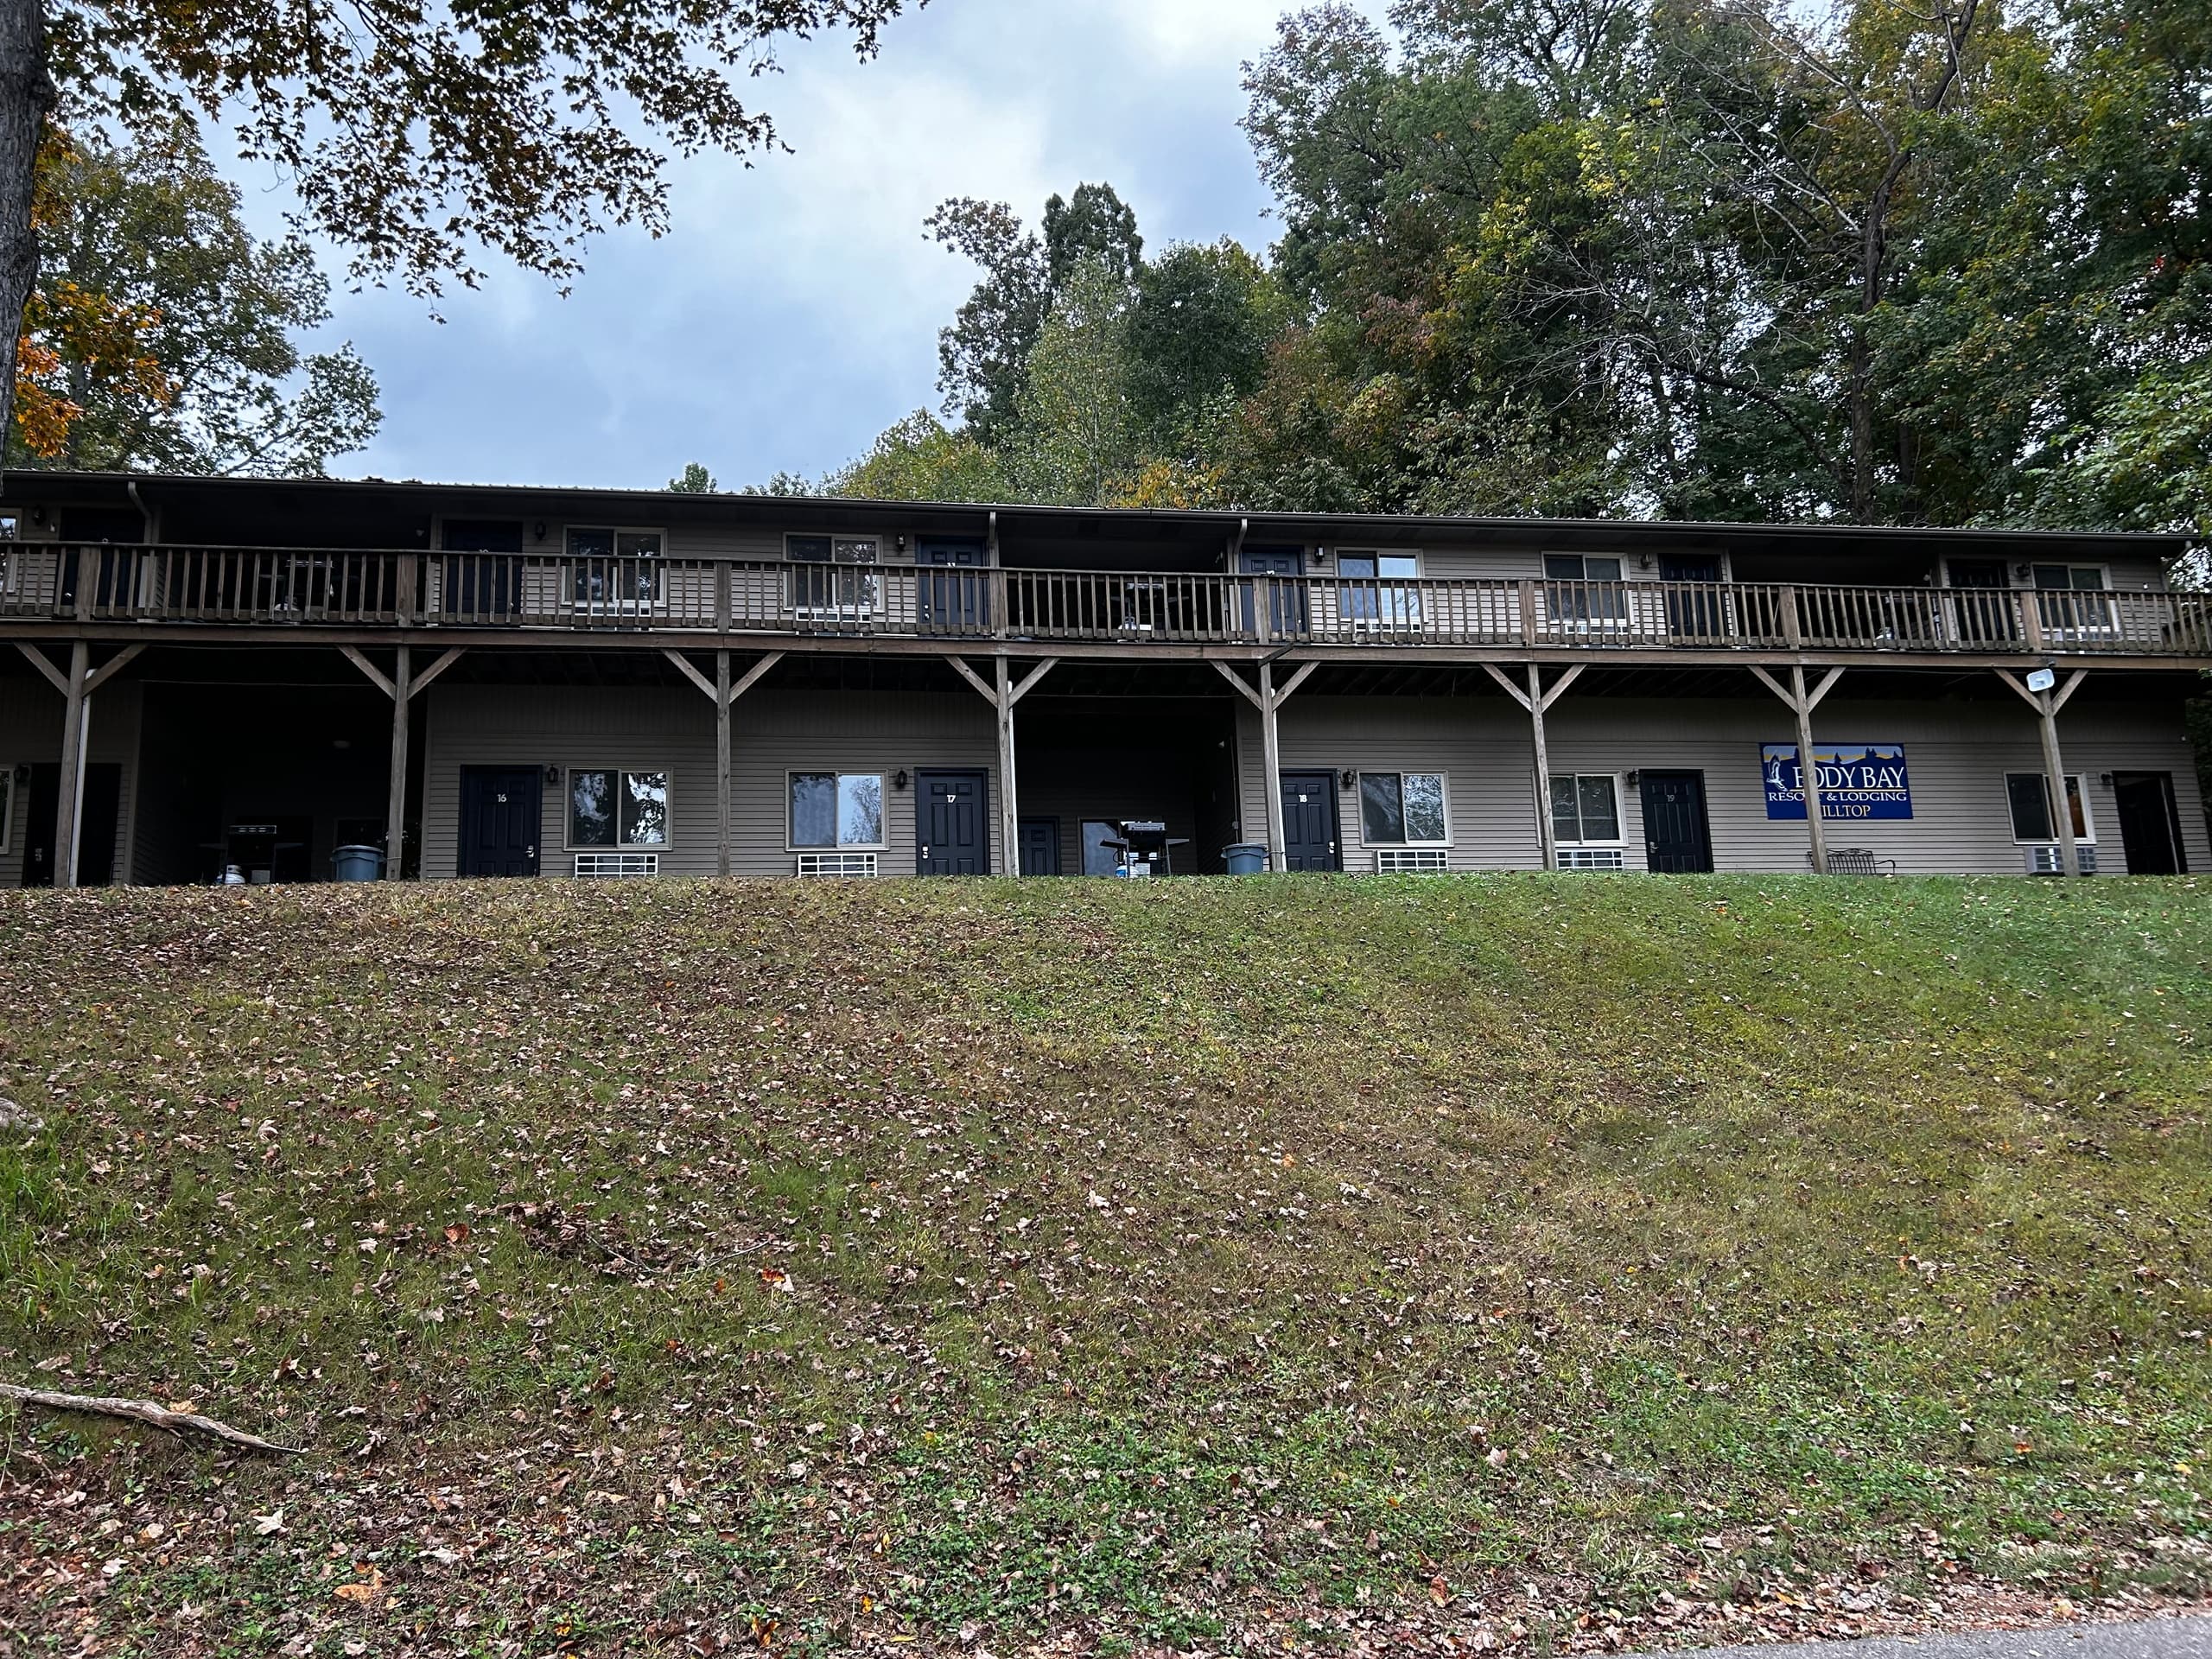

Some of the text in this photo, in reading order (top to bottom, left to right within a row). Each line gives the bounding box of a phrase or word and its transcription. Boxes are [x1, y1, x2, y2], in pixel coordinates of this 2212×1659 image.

[1860, 766, 1904, 788] BAY
[497, 793, 507, 803] 16
[946, 794, 957, 804] 17
[1298, 794, 1308, 803] 18
[1666, 794, 1675, 803] 19
[1769, 792, 1907, 802] RESO & LODGING
[1821, 804, 1872, 817] ILLTOP
